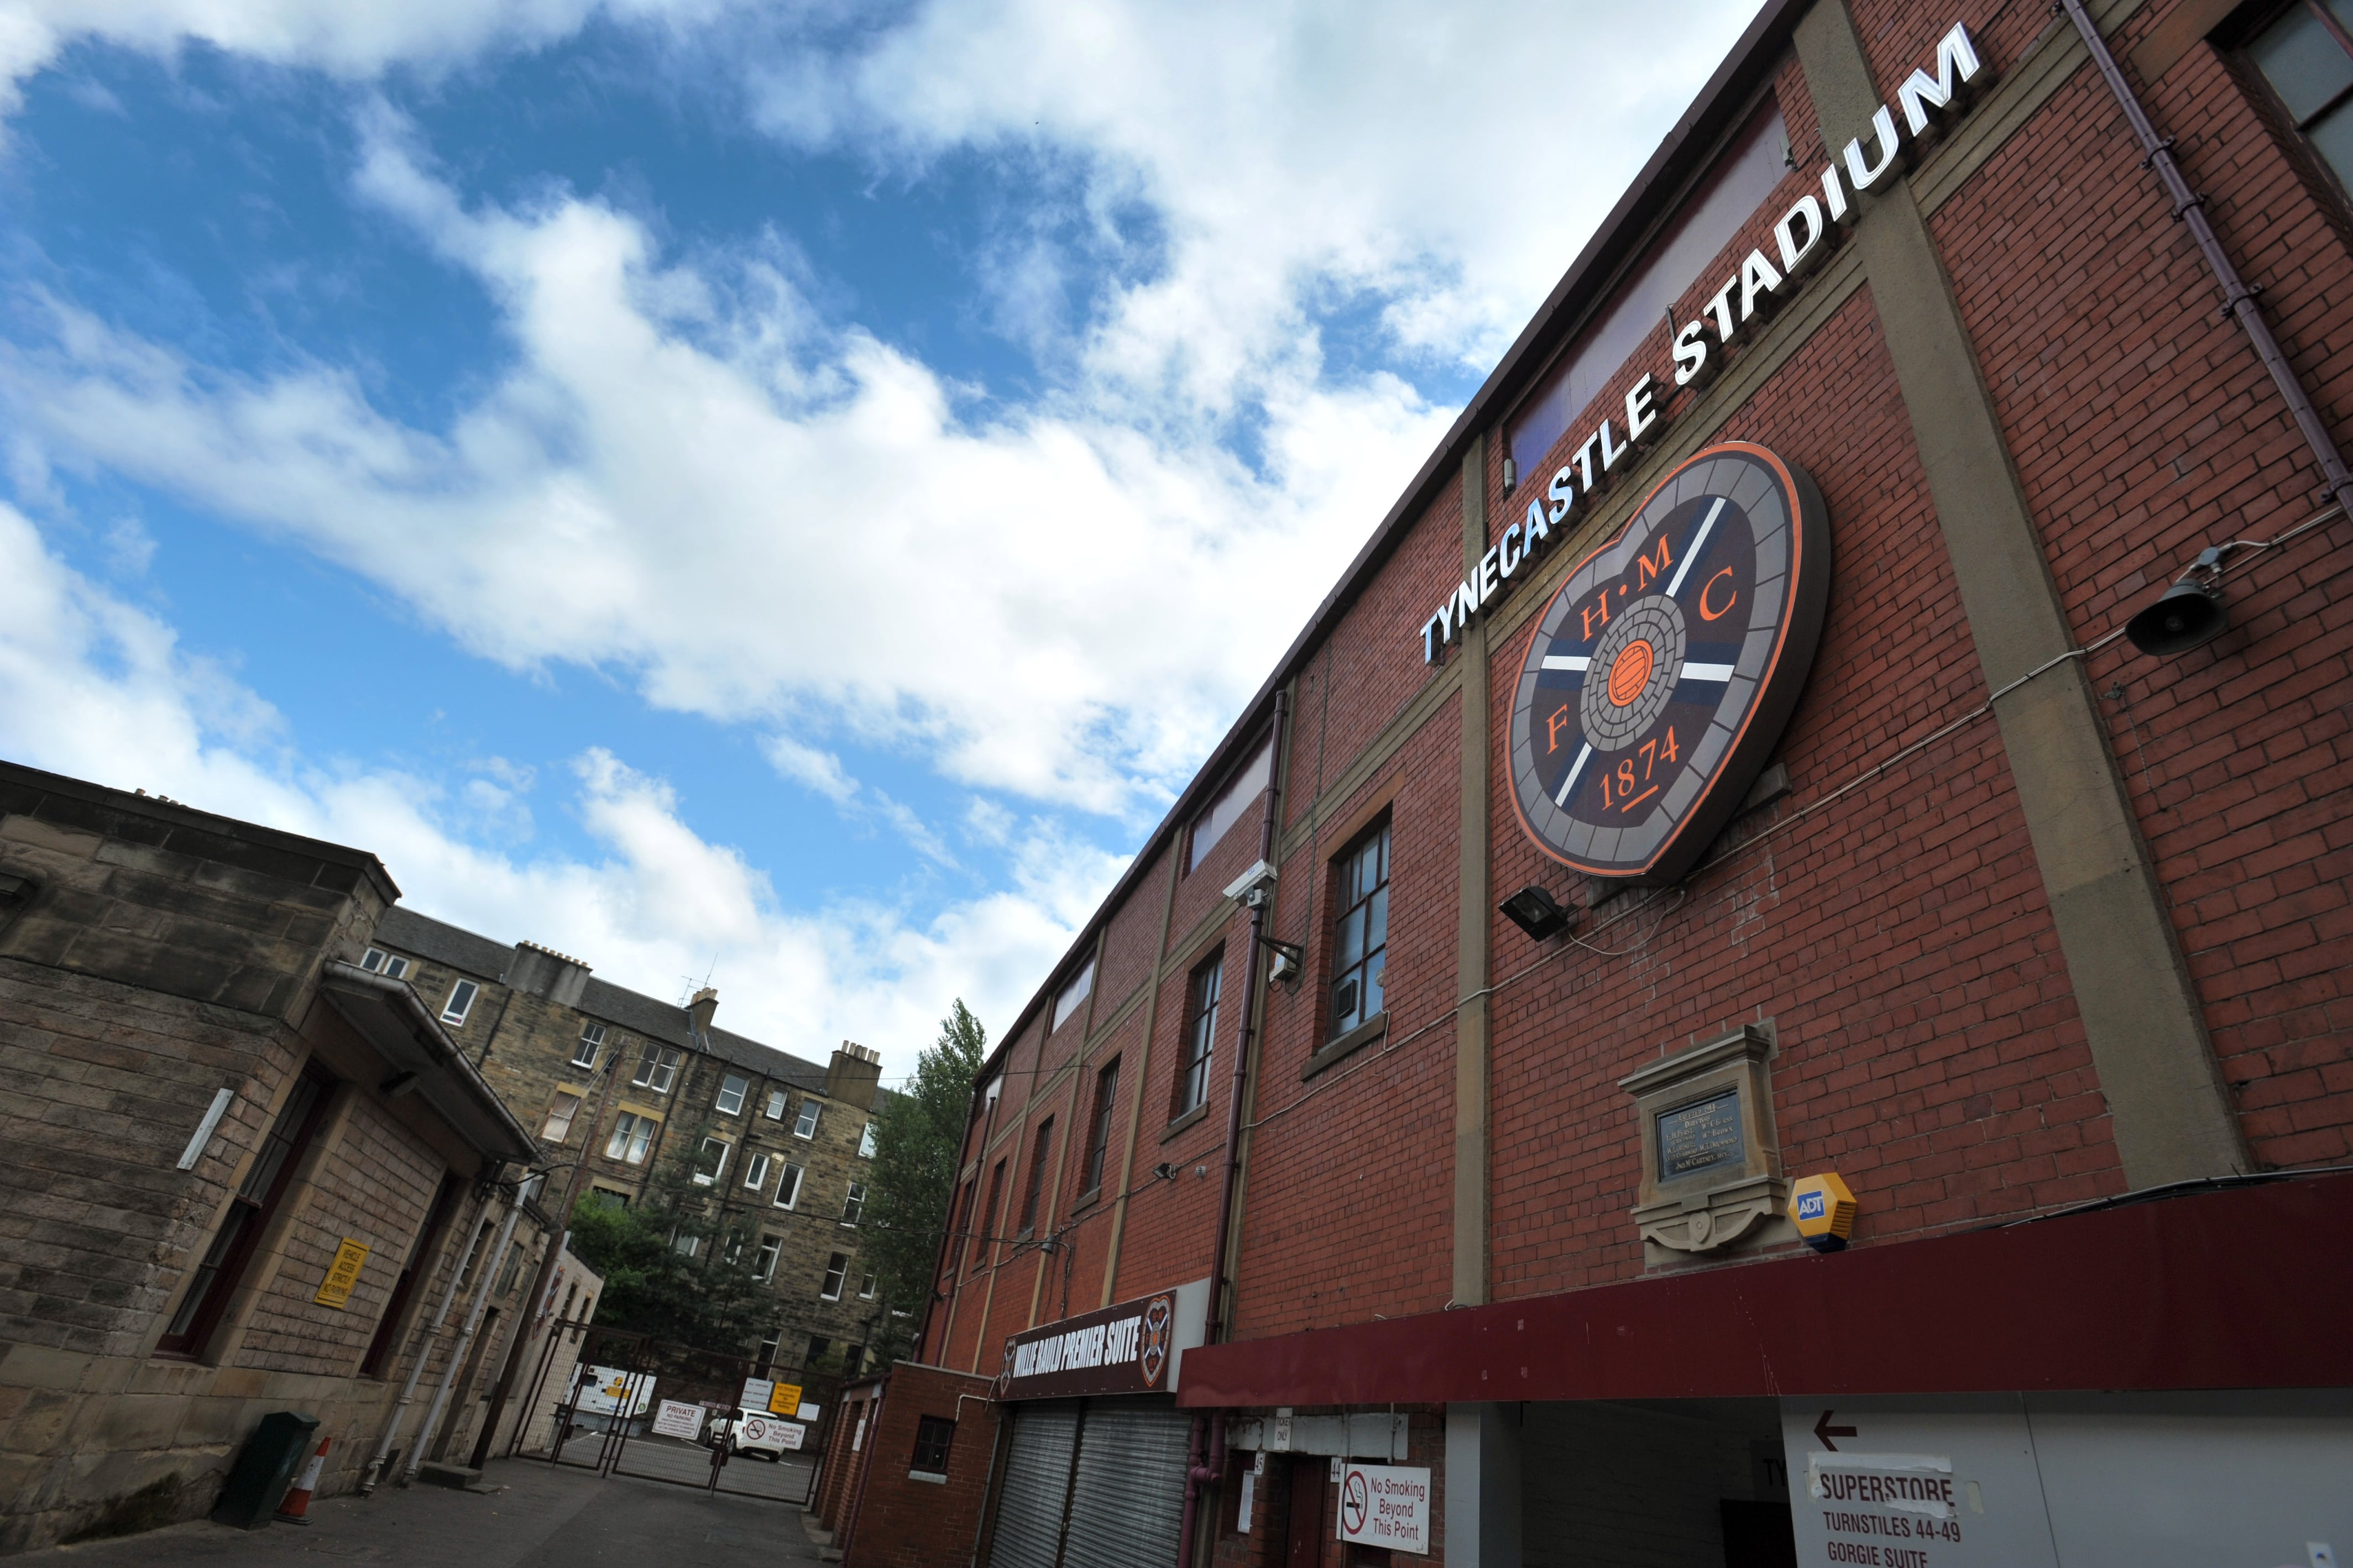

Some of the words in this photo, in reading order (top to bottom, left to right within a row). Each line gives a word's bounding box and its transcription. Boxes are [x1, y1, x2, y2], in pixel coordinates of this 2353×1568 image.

[1420, 371, 1656, 663] TYNECASTLE
[1672, 20, 1981, 386] STADIUM
[1601, 725, 1680, 811] 1874
[1799, 1196, 1823, 1215] ADT
[338, 1261, 355, 1273] ACCESS
[1013, 1341, 1039, 1378] WILLIE
[1034, 1334, 1064, 1375] BAULD
[1060, 1324, 1106, 1371] PREMIER
[1105, 1315, 1142, 1366] SUITE
[666, 1405, 696, 1417] PRIVATE
[778, 1425, 802, 1435] Smoking
[1277, 1417, 1291, 1427] TICKET
[773, 1430, 795, 1439] Beyond
[781, 1438, 797, 1446] Point
[1277, 1430, 1288, 1441] ONLY
[1256, 1456, 1263, 1471] 45
[1331, 1462, 1340, 1478] 44
[1371, 1477, 1383, 1493] No
[1385, 1478, 1425, 1502] Smoking
[1819, 1473, 1955, 1507] SUPERSTORE
[1379, 1498, 1414, 1519] Beyond
[1373, 1518, 1392, 1536] This
[1394, 1520, 1419, 1540] Point
[1823, 1512, 1911, 1538] TURNSTILES
[1916, 1519, 1961, 1543] 44-49
[1828, 1541, 1881, 1566] GORGIE
[1884, 1547, 1928, 1568] SUITE
